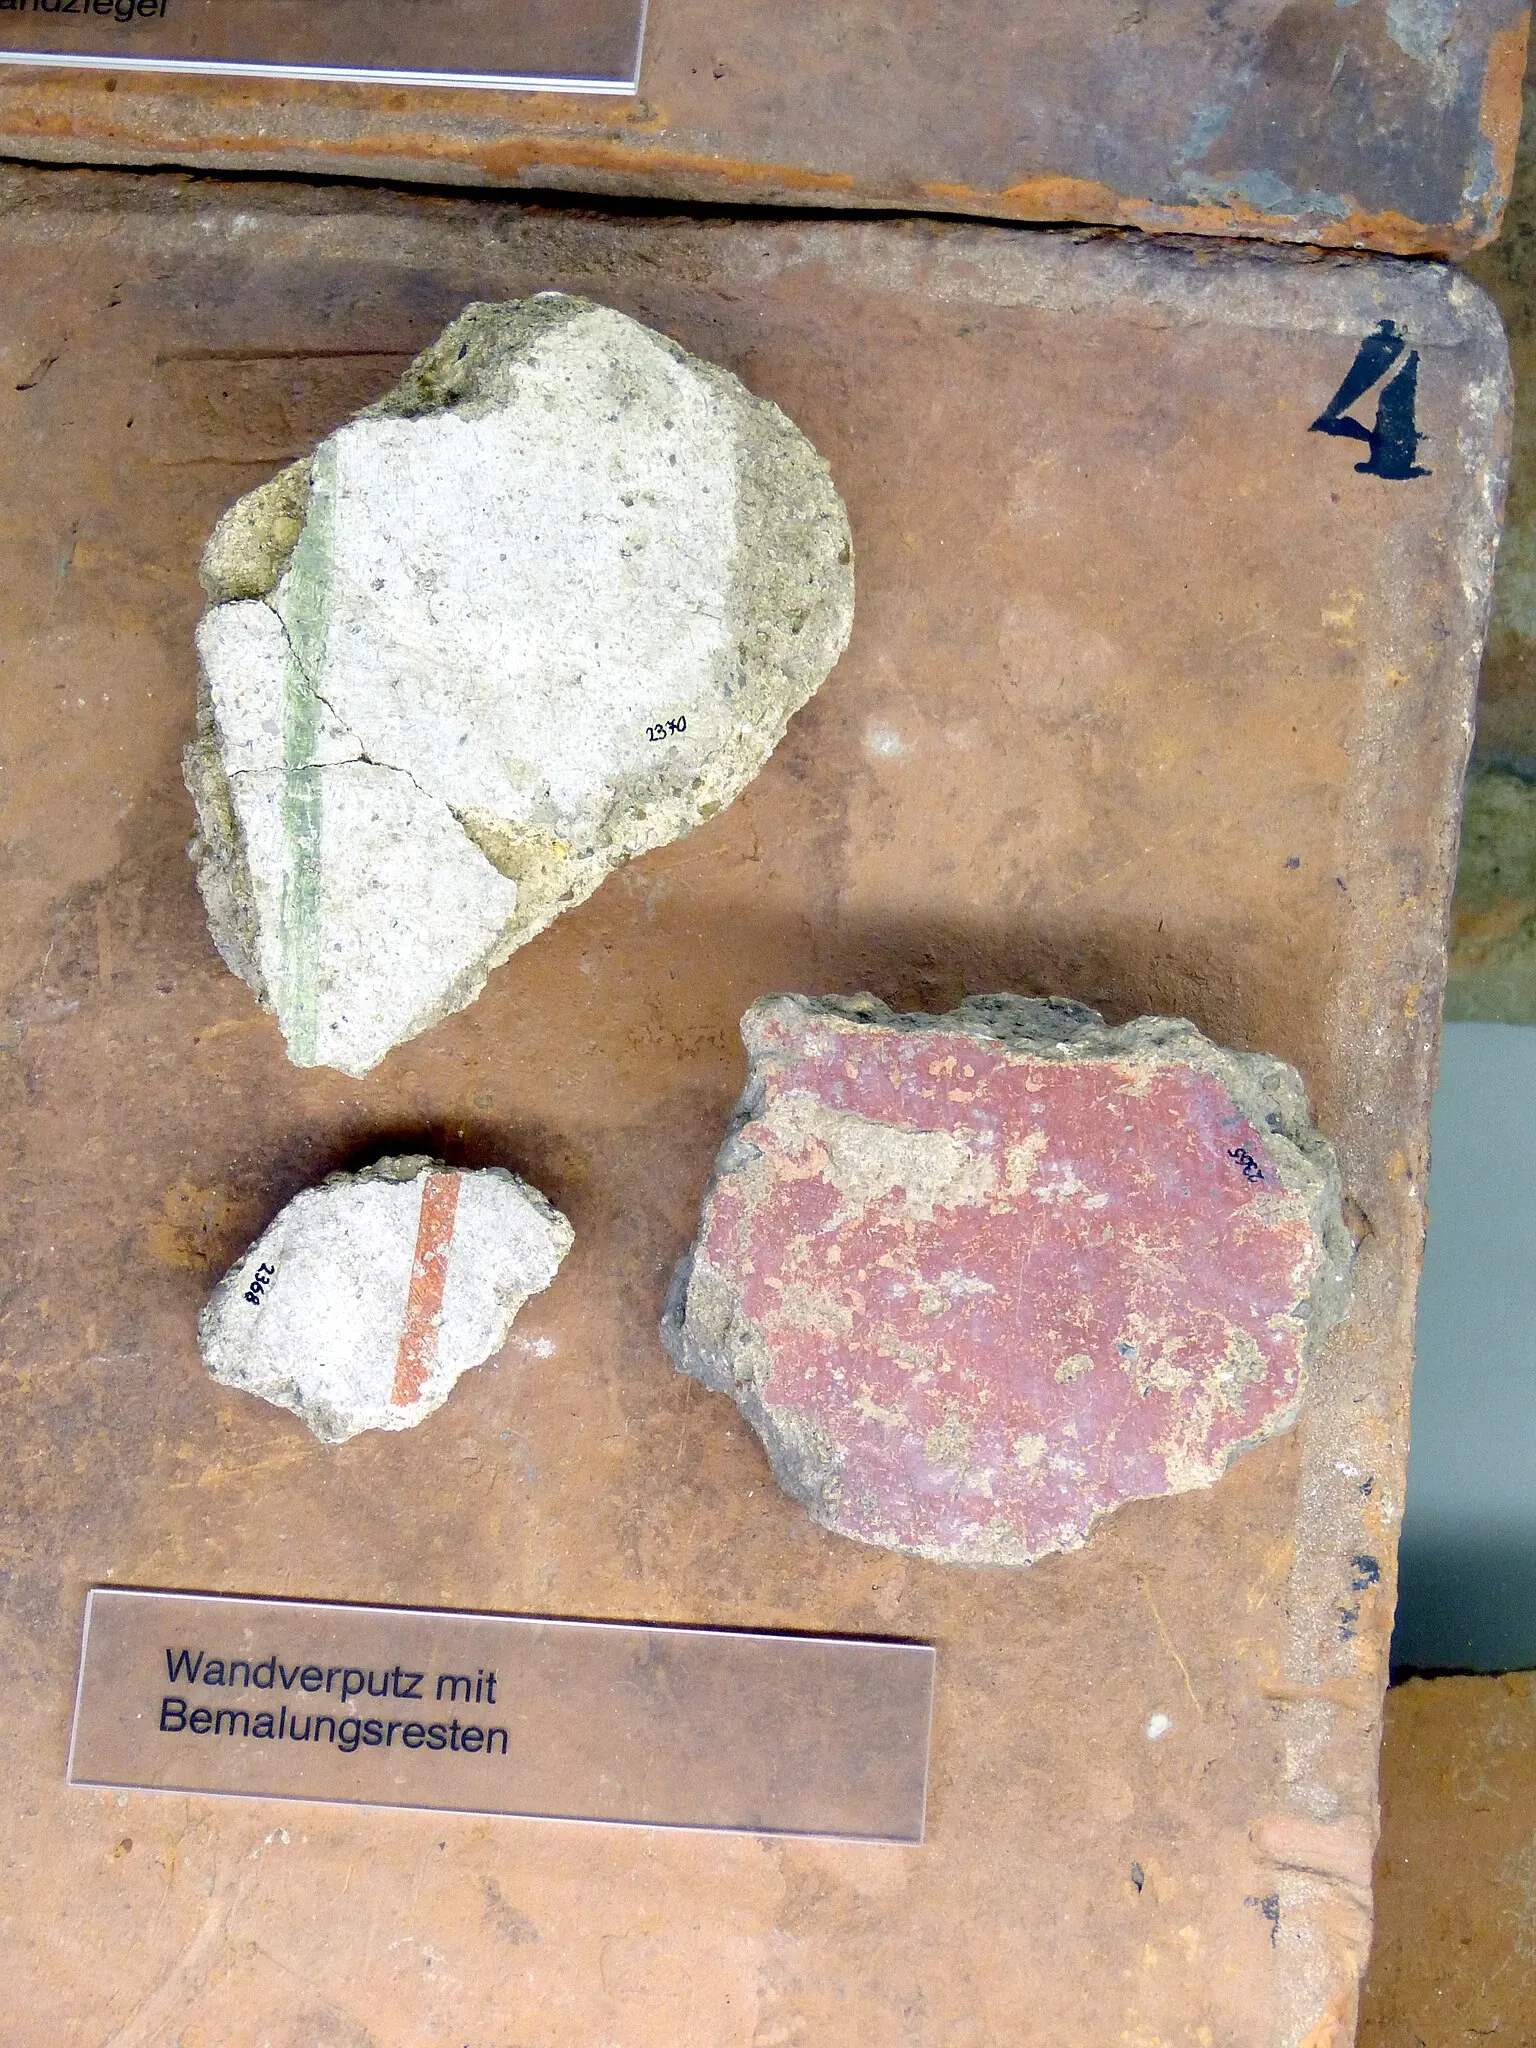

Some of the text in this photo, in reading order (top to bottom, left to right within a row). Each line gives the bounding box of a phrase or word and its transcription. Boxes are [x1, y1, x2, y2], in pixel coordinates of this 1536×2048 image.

[1307, 319, 1433, 480] 4
[645, 715, 687, 742] 2370
[244, 1262, 275, 1306] 2368
[165, 1648, 497, 1704] Wandverputz mit
[159, 1696, 509, 1755] Bemalungsresten
